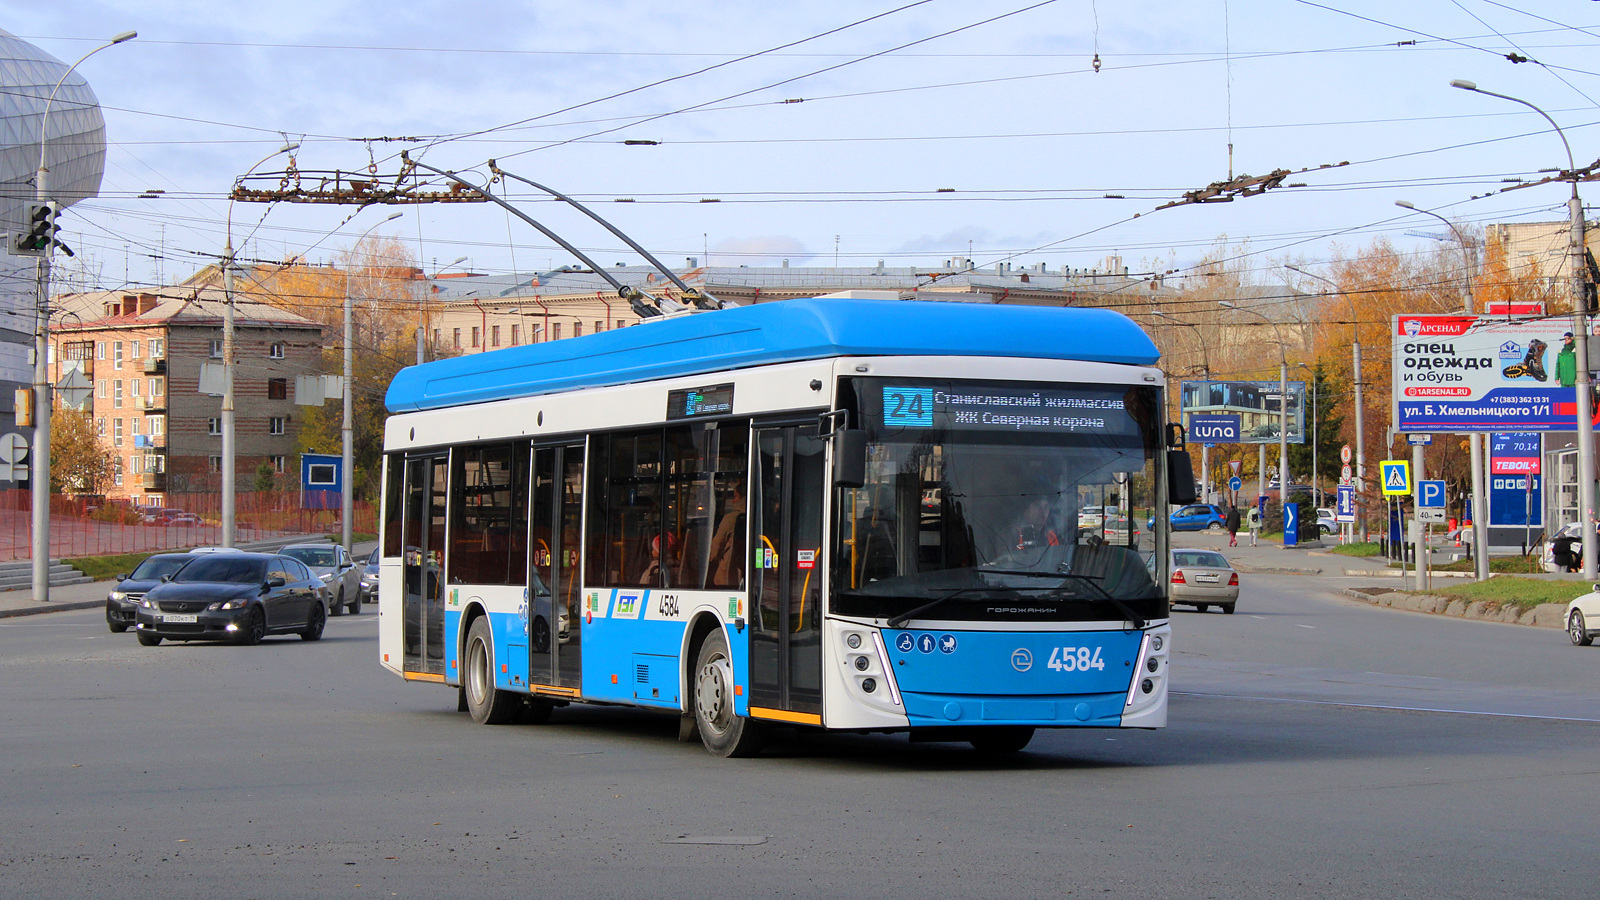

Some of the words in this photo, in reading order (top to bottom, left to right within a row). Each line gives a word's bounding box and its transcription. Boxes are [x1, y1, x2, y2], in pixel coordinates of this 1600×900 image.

[1420, 324, 1461, 333] АРСЕНАЛ
[1403, 343, 1456, 356] спец
[1403, 357, 1492, 370] одежда
[1404, 374, 1413, 382] и
[1416, 372, 1462, 384] обувь
[890, 394, 924, 418] 24
[934, 392, 1041, 407] Станиславский
[1044, 396, 1124, 410] жилмассив
[1404, 408, 1422, 418] ул.
[1424, 405, 1436, 415] Б.
[1438, 405, 1530, 417] Хмельницкого
[1532, 405, 1549, 416] 1/1
[955, 411, 978, 424] ЖК
[982, 412, 1050, 429] Северная
[1053, 415, 1104, 430] корона
[1514, 443, 1538, 451] 70,14
[660, 594, 680, 618] 4584
[1048, 646, 1104, 672] 4584
